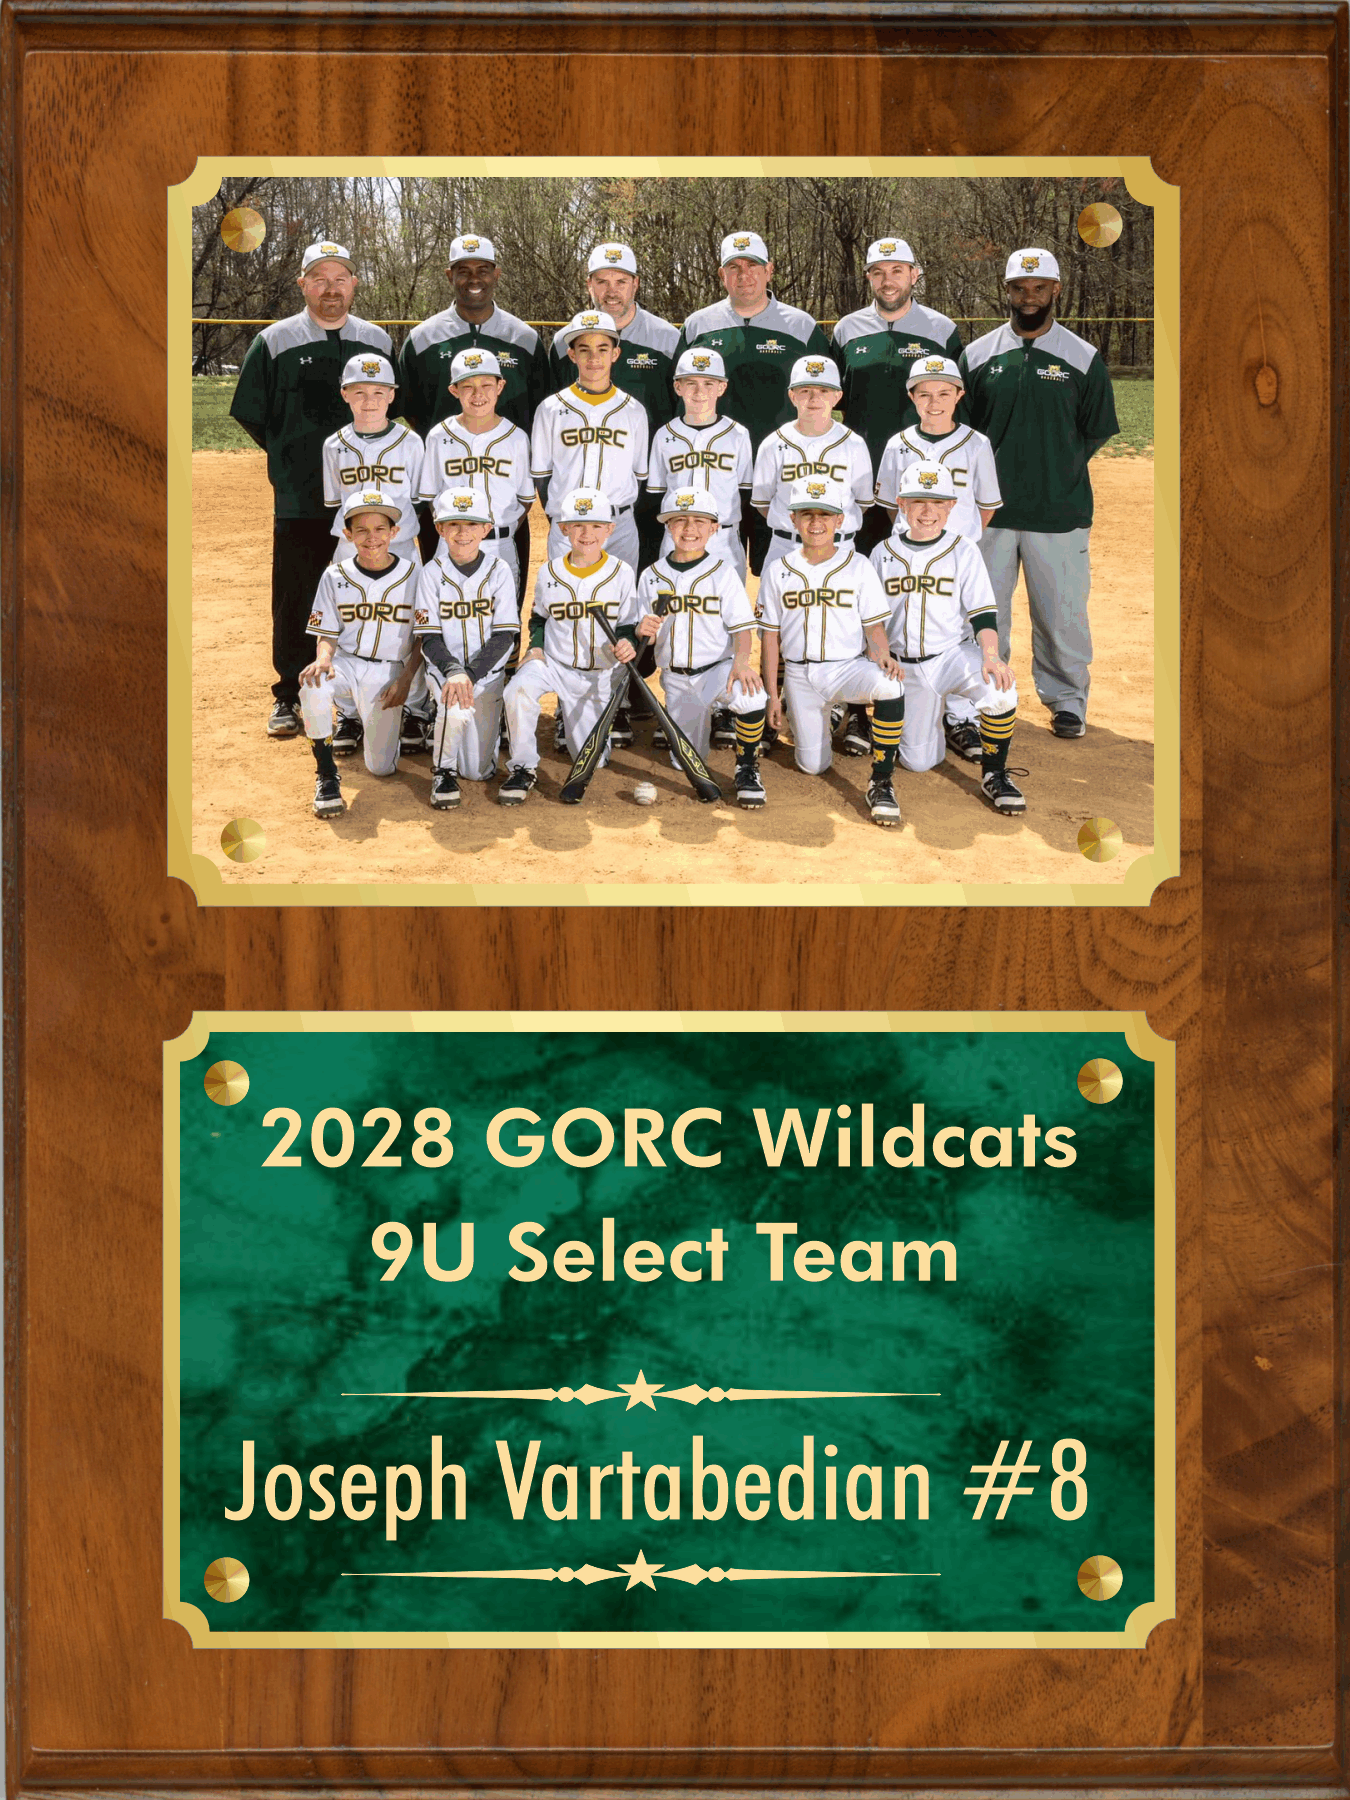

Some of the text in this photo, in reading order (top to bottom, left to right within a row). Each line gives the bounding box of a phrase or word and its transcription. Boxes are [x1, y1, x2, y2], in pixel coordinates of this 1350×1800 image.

[560, 426, 628, 449] GORC
[444, 455, 512, 478] GORC
[668, 450, 736, 472] GORC
[340, 463, 406, 485] GORC
[884, 575, 955, 597] GORC
[782, 588, 855, 609] GORC
[337, 602, 413, 624] GORC
[262, 1103, 1077, 1168] 2028 GORC Wildcats
[372, 1217, 957, 1283] 9U Select Team
[225, 1435, 1088, 1541] Joseph Vartabedian #8
